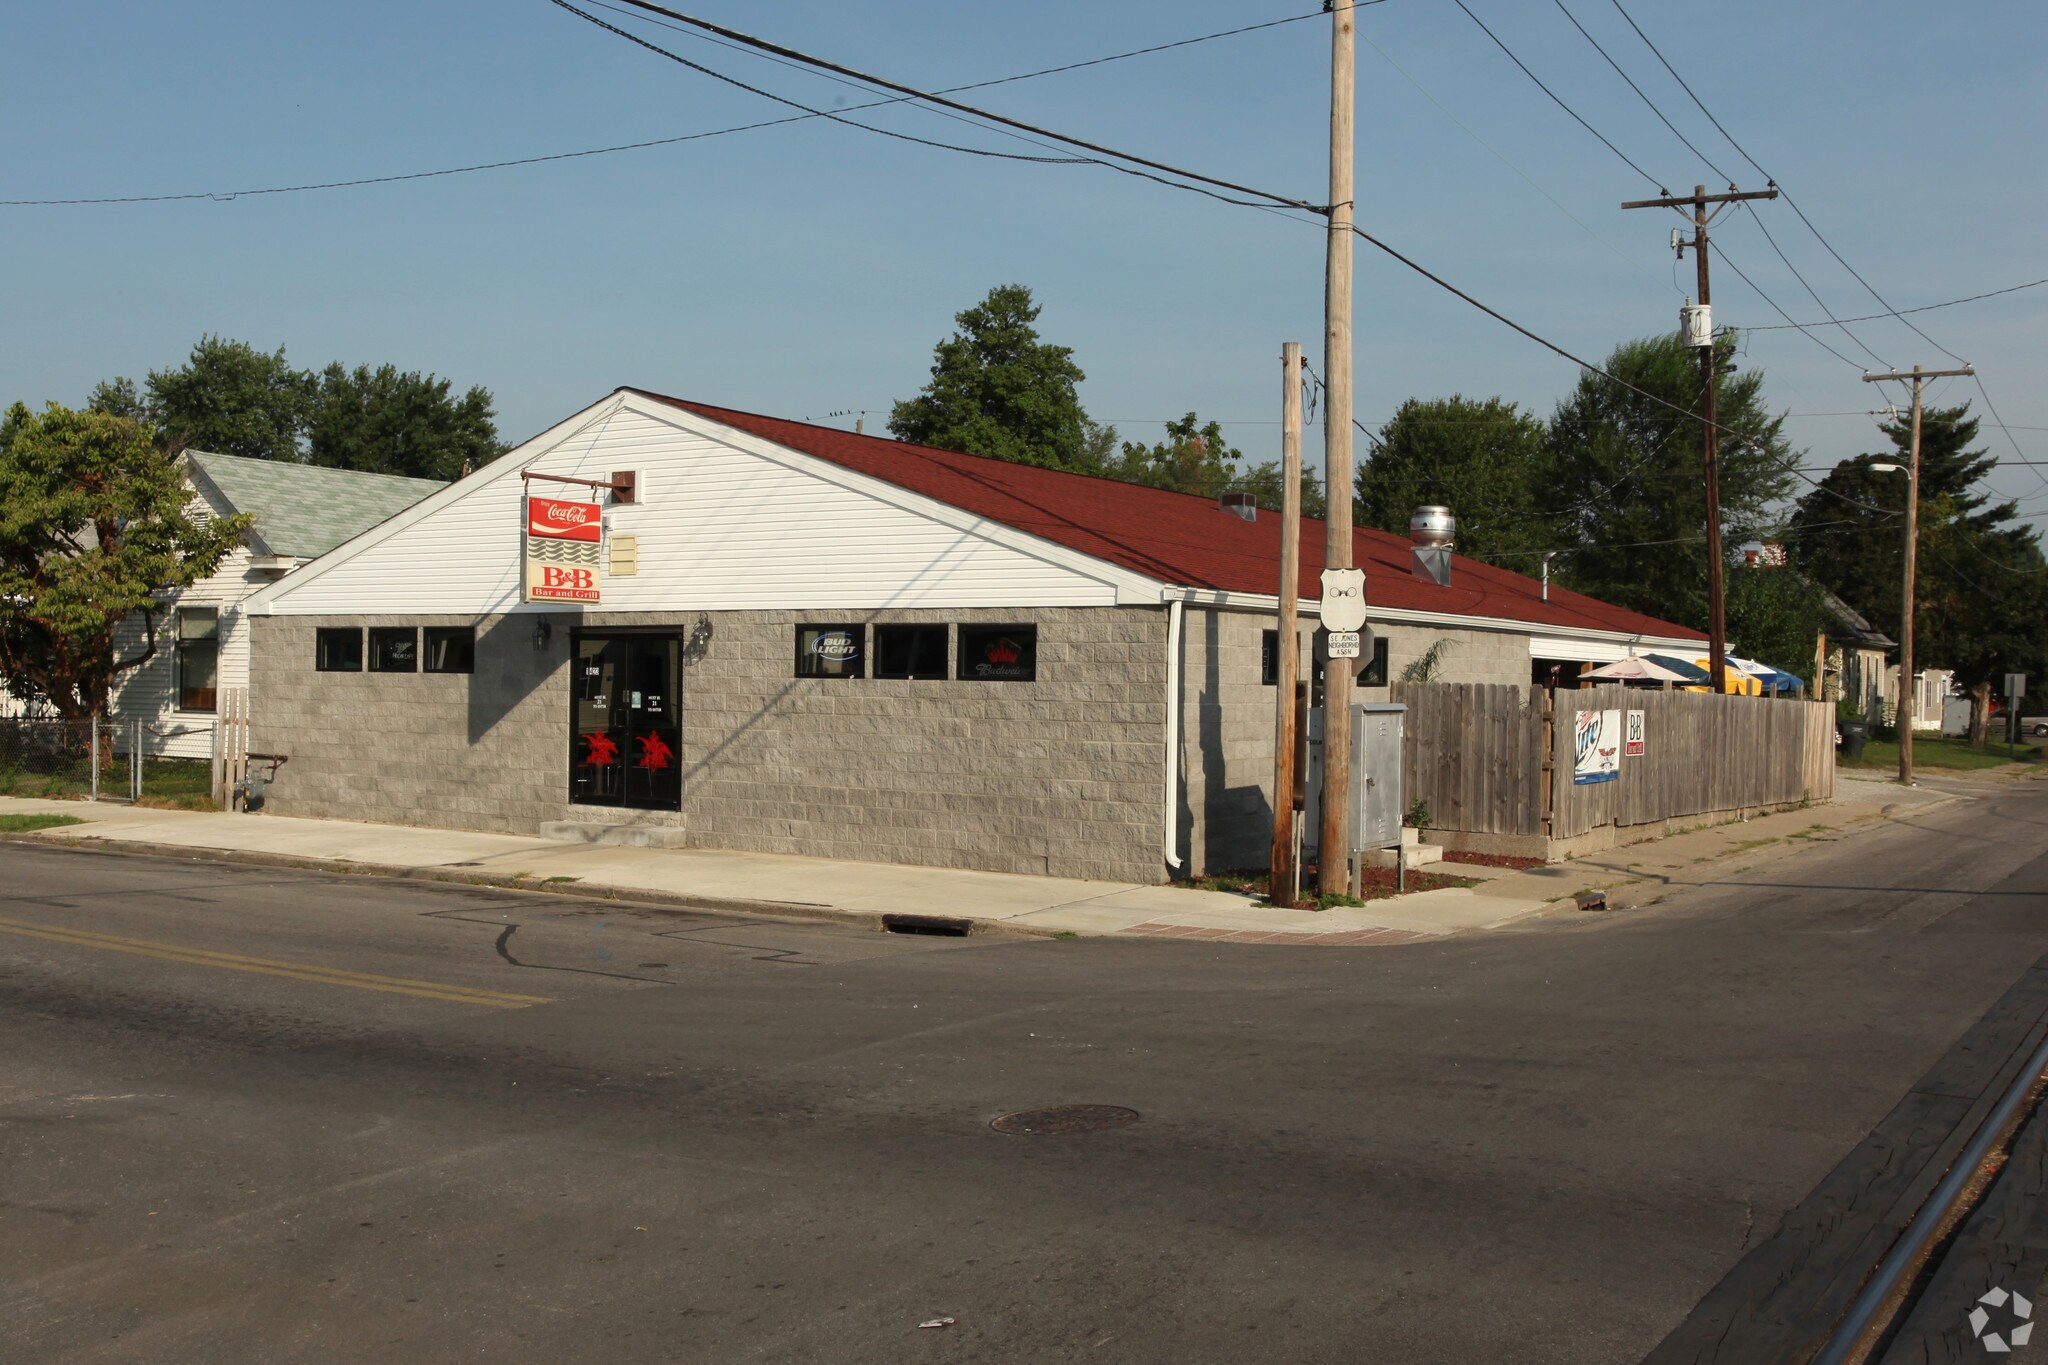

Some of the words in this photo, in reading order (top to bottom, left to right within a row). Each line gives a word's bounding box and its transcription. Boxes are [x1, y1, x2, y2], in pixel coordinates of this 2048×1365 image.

[542, 566, 593, 589] B&B
[535, 588, 553, 596] Bar
[576, 590, 598, 599] Grill
[823, 638, 852, 646] BUD
[817, 645, 856, 654] LIGHT
